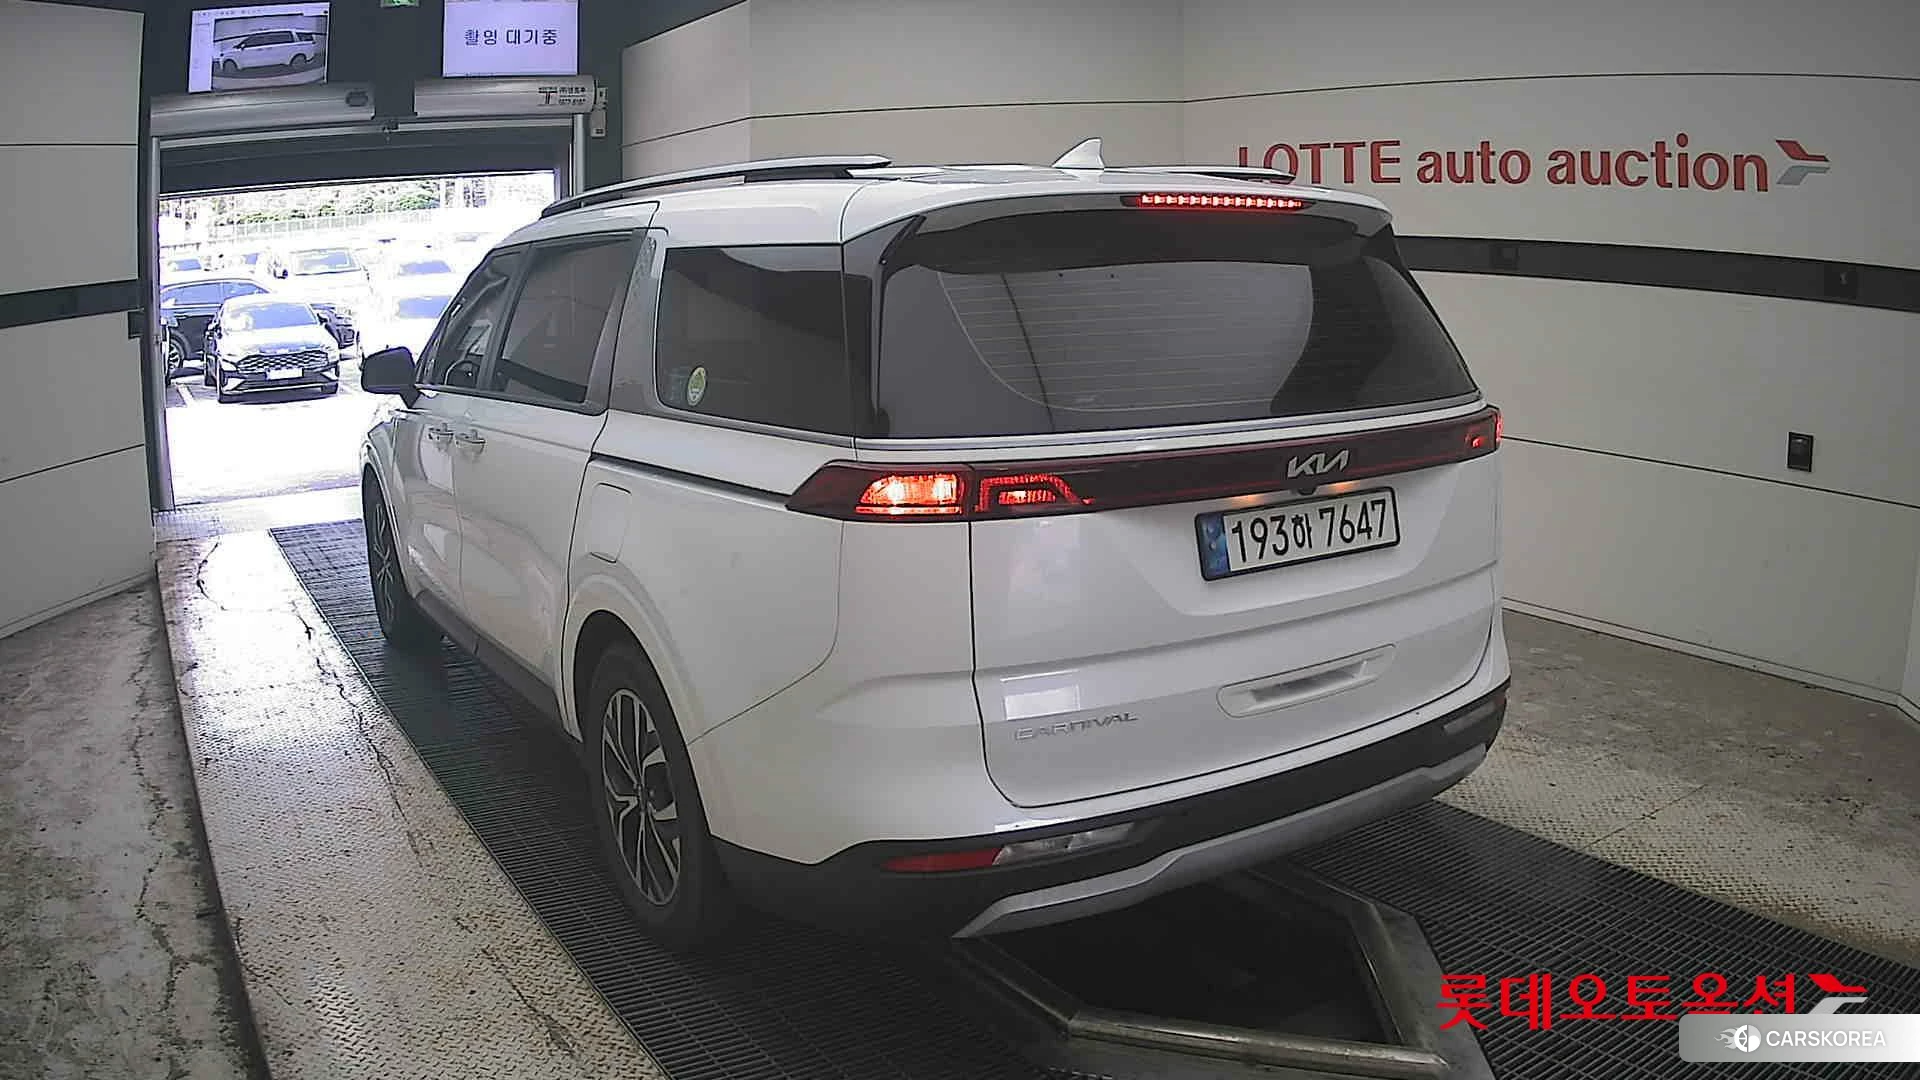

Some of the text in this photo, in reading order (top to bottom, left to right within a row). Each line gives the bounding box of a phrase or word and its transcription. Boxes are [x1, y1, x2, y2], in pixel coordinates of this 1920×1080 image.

[506, 29, 557, 46] 대기중
[1416, 140, 1532, 184] auto
[1546, 132, 1769, 193] auction
[1231, 498, 1387, 563] 193하 7647
[1014, 711, 1139, 741] CARNIVAL
